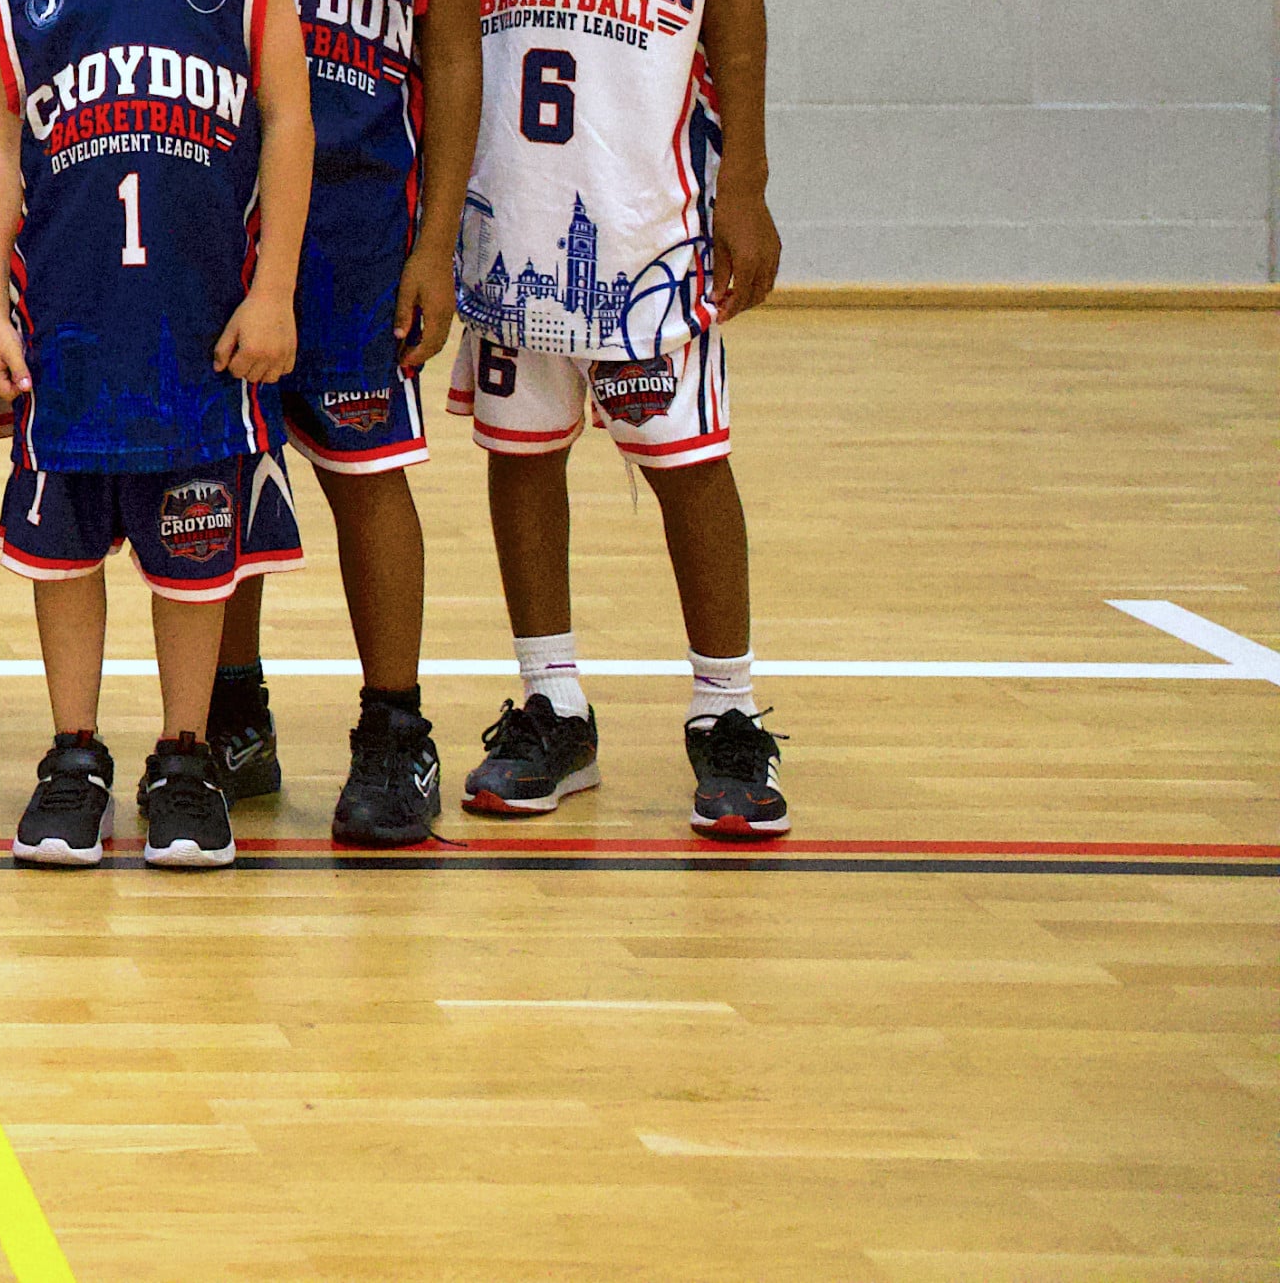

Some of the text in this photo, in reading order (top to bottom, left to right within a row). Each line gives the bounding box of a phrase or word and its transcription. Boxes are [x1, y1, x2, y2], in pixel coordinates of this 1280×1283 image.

[583, 15, 649, 51] LEAGUE
[316, 59, 376, 97] LEAGUE
[520, 47, 577, 145] 6
[50, 100, 216, 156] BASKETBALL
[51, 133, 211, 175] DEVELOPMENT LEAGUE
[117, 171, 148, 267] 1
[477, 337, 518, 398] 6
[595, 376, 675, 401] CROYDON
[161, 514, 233, 536] CROYDON
